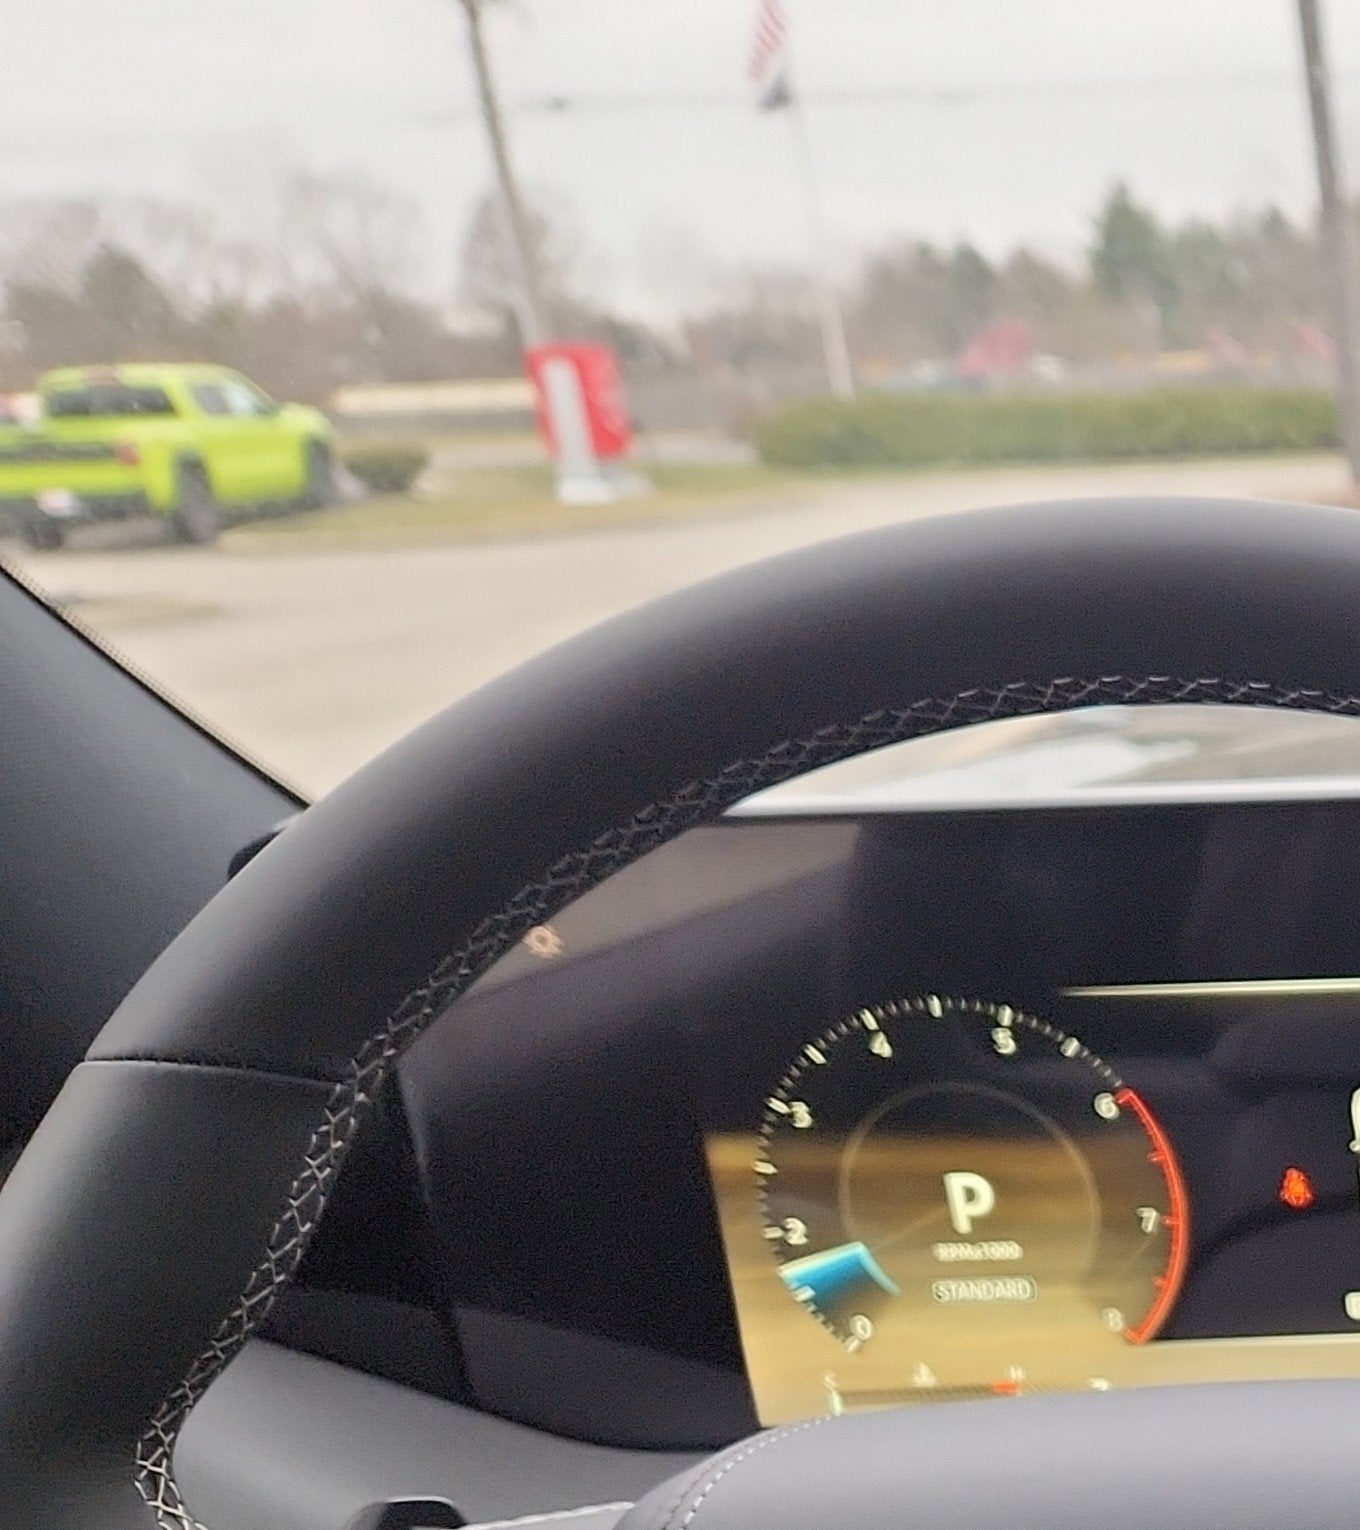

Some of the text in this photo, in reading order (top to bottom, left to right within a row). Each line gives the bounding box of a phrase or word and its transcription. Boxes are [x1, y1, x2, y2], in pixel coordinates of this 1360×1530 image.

[869, 1030, 894, 1060] 4
[991, 1026, 1017, 1055] 5
[788, 1102, 813, 1129] 3
[1093, 1091, 1120, 1121] 6
[943, 1171, 995, 1235] P
[784, 1217, 808, 1247] 2
[1136, 1207, 1159, 1235] 7
[933, 1278, 1032, 1302] STANDARD
[851, 1314, 875, 1341] 0
